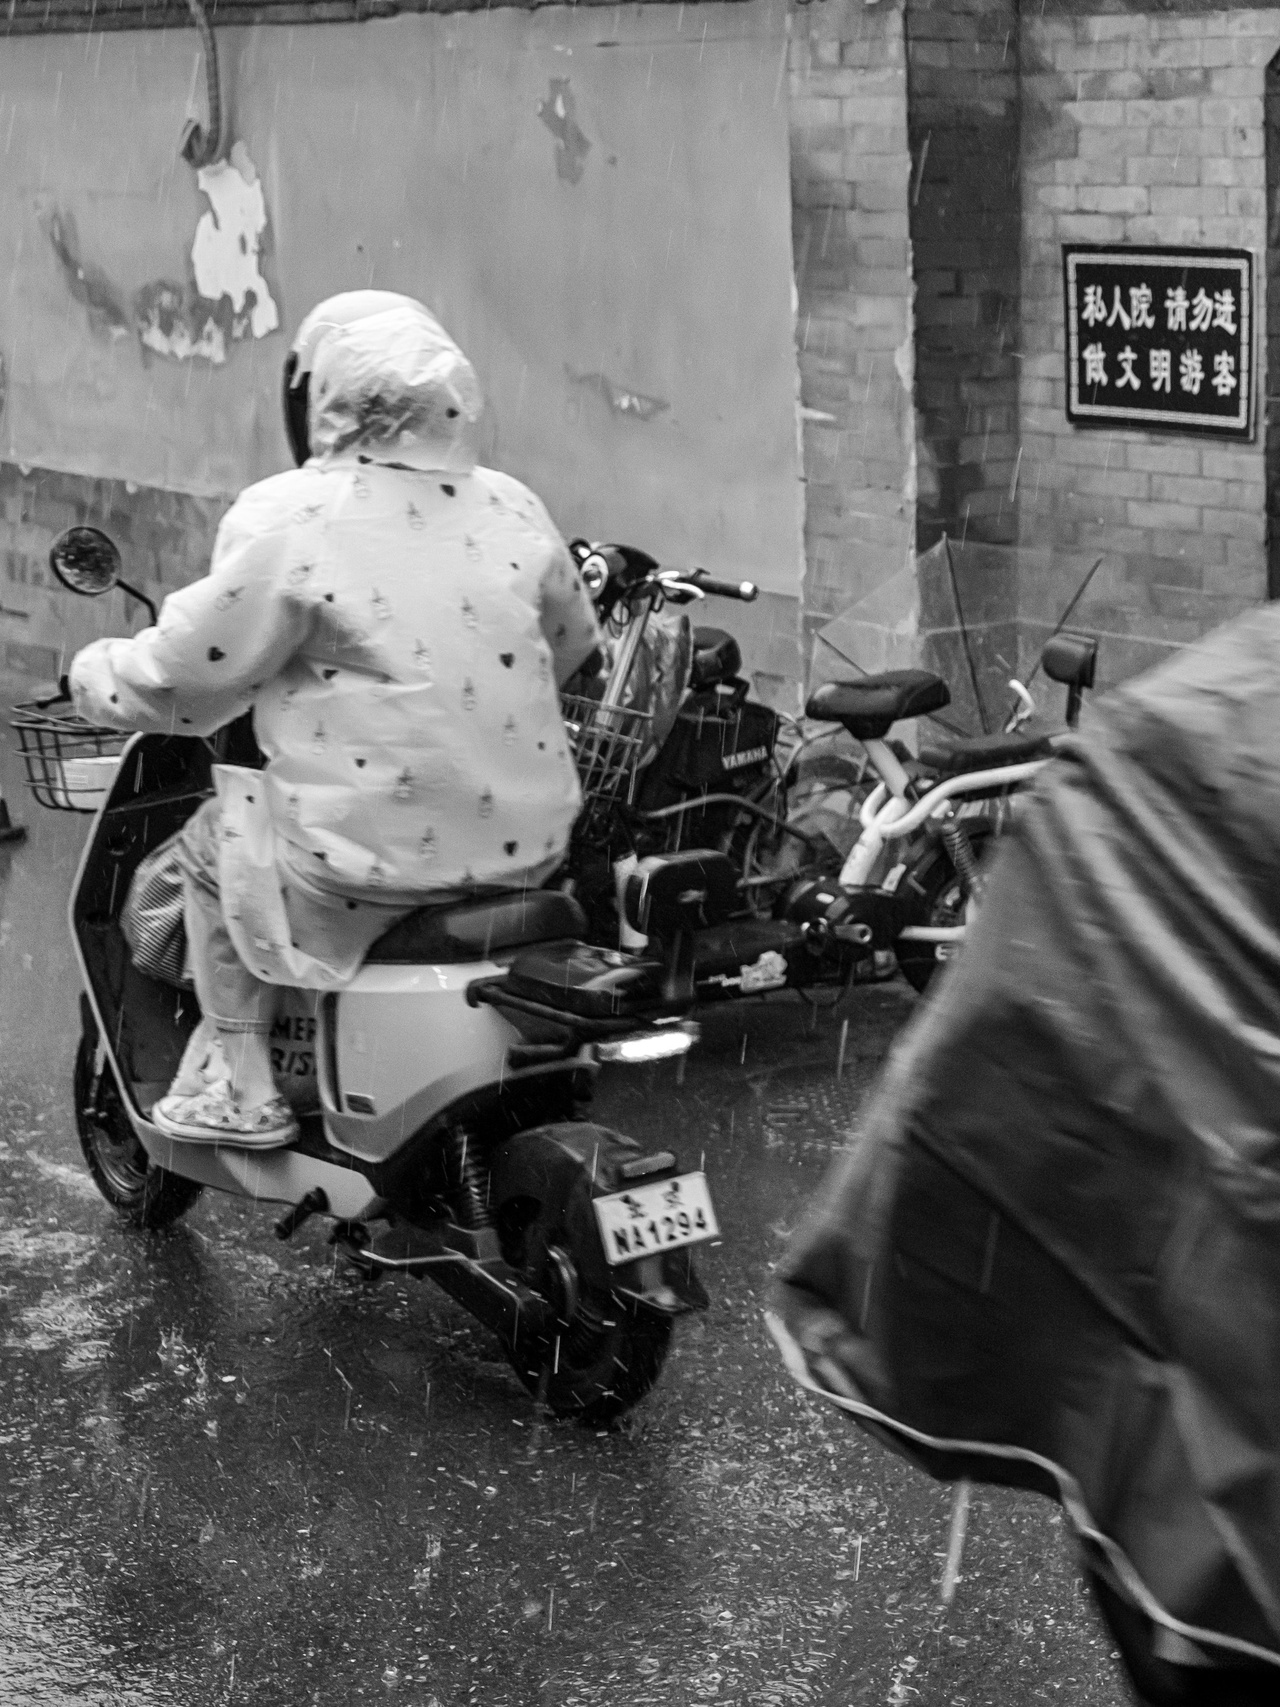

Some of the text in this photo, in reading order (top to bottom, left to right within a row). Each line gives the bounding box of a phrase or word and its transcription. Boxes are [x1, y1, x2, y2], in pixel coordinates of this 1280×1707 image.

[1081, 282, 1238, 336] 私人院 请勿进
[1082, 342, 1238, 397] 做文明游客
